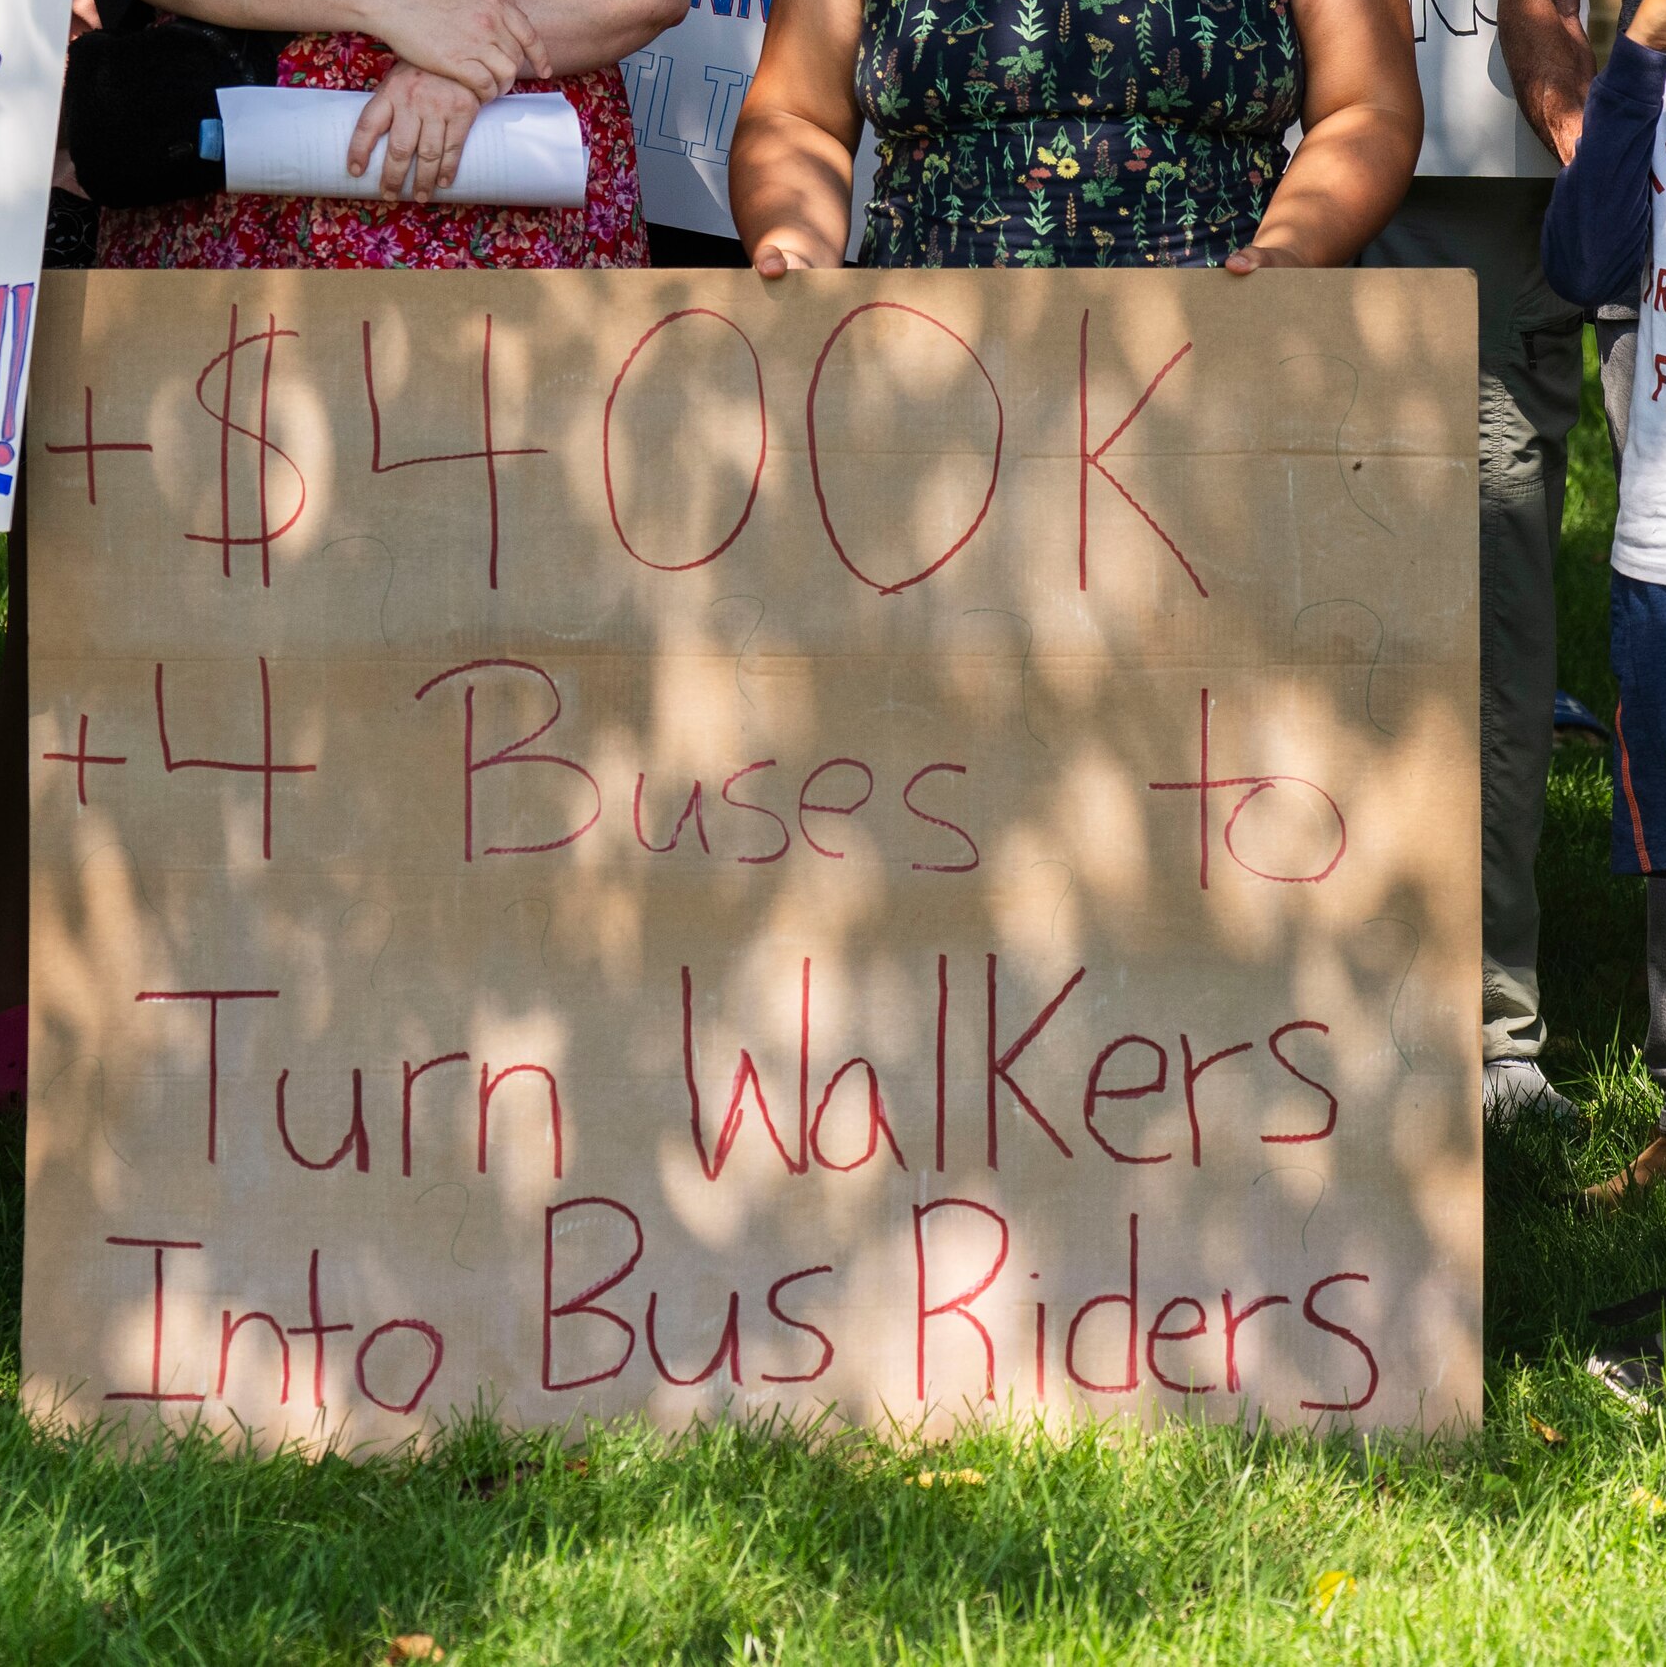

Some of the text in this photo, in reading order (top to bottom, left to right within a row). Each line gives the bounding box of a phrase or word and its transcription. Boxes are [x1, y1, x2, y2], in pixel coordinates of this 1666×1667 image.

[43, 655, 1347, 890] +4 Buses to
[136, 989, 564, 1180] Turn
[106, 1196, 1379, 1413] Into Bus Riders
